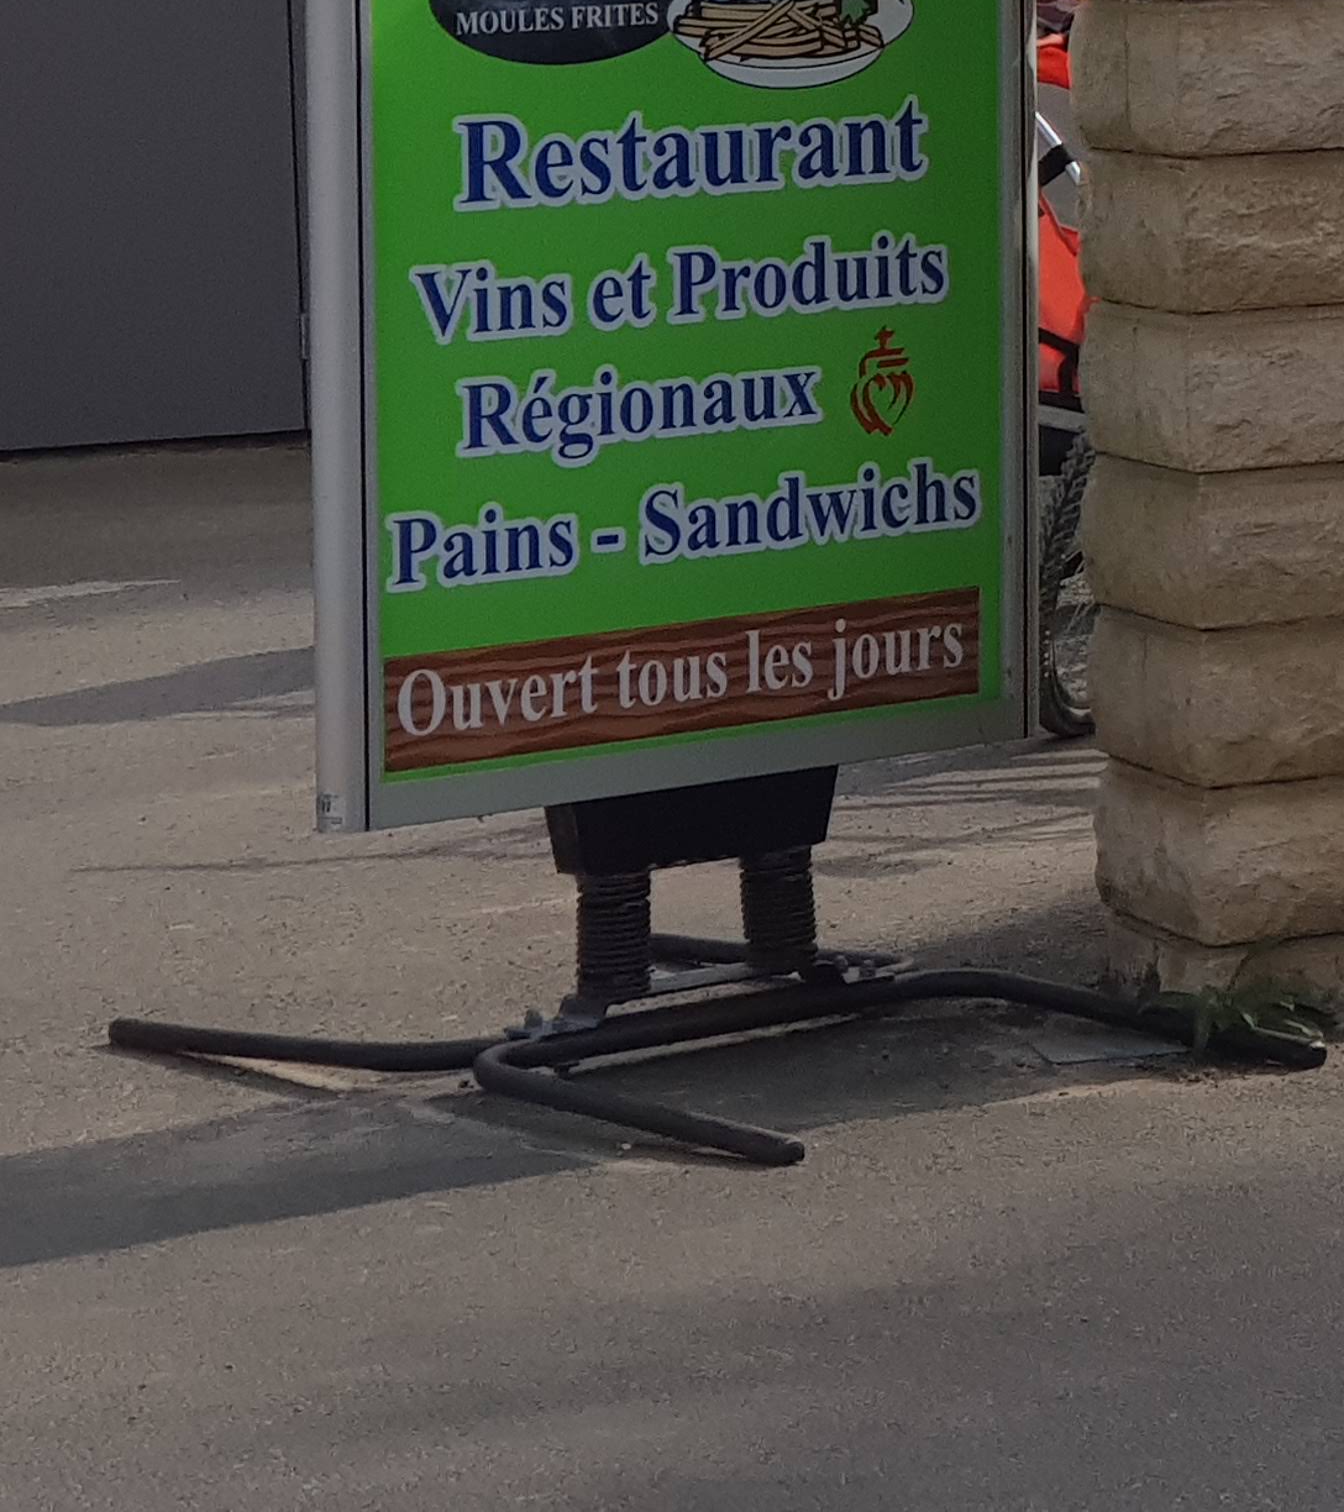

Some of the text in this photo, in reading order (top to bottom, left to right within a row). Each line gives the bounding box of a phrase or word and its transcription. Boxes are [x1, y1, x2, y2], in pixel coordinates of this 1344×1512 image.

[456, 2, 658, 35] MOULES FRITES
[457, 95, 926, 206] Restaurant
[412, 233, 946, 342] Vins et Produits
[460, 364, 820, 461] Régionaux
[390, 508, 576, 588] Pains
[642, 462, 979, 560] Sandwichs
[397, 618, 963, 737] Ouvert tous les jours
